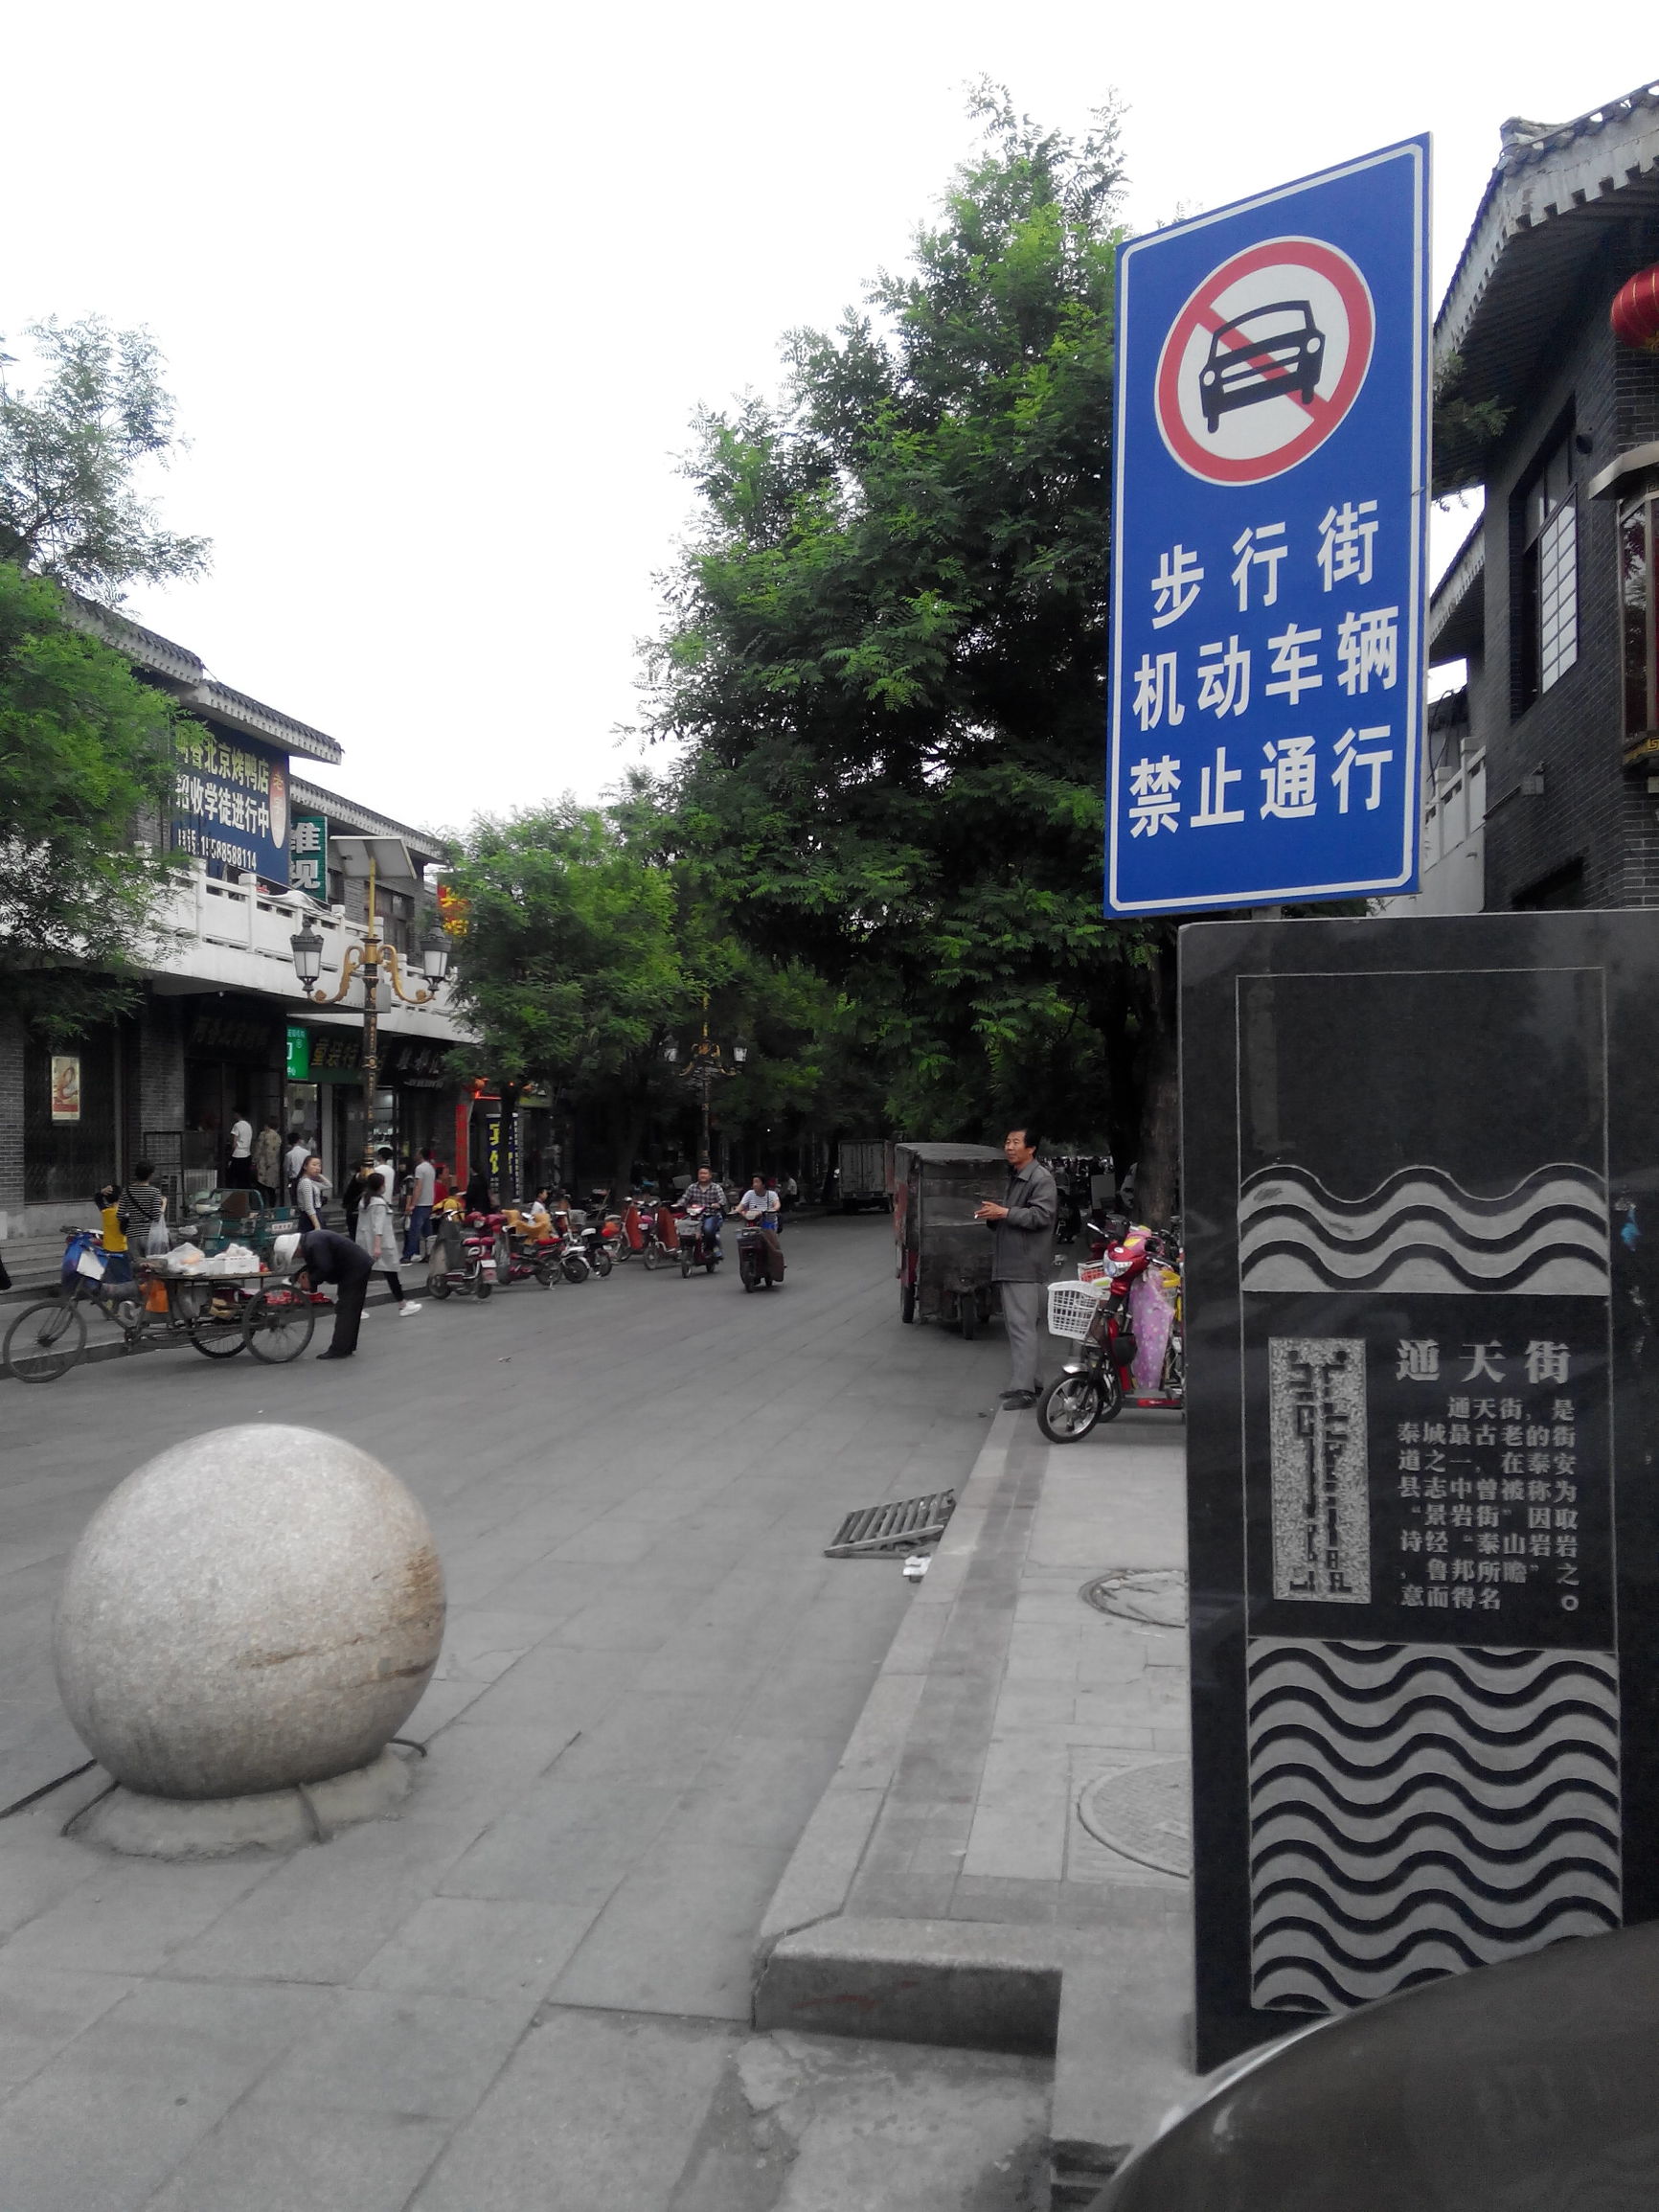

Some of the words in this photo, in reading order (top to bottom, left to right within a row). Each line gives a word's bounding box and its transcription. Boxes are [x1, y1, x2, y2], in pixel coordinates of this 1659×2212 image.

[1151, 499, 1379, 630] 步行街
[1132, 605, 1398, 732] 机动车辆
[1129, 724, 1394, 839] 禁止通行
[1396, 1338, 1571, 1384] 通天街
[1447, 1396, 1576, 1422] 通天街，是
[1398, 1421, 1577, 1448] 泰城最古老的街
[1398, 1475, 1579, 1504] 县志中曾被称为
